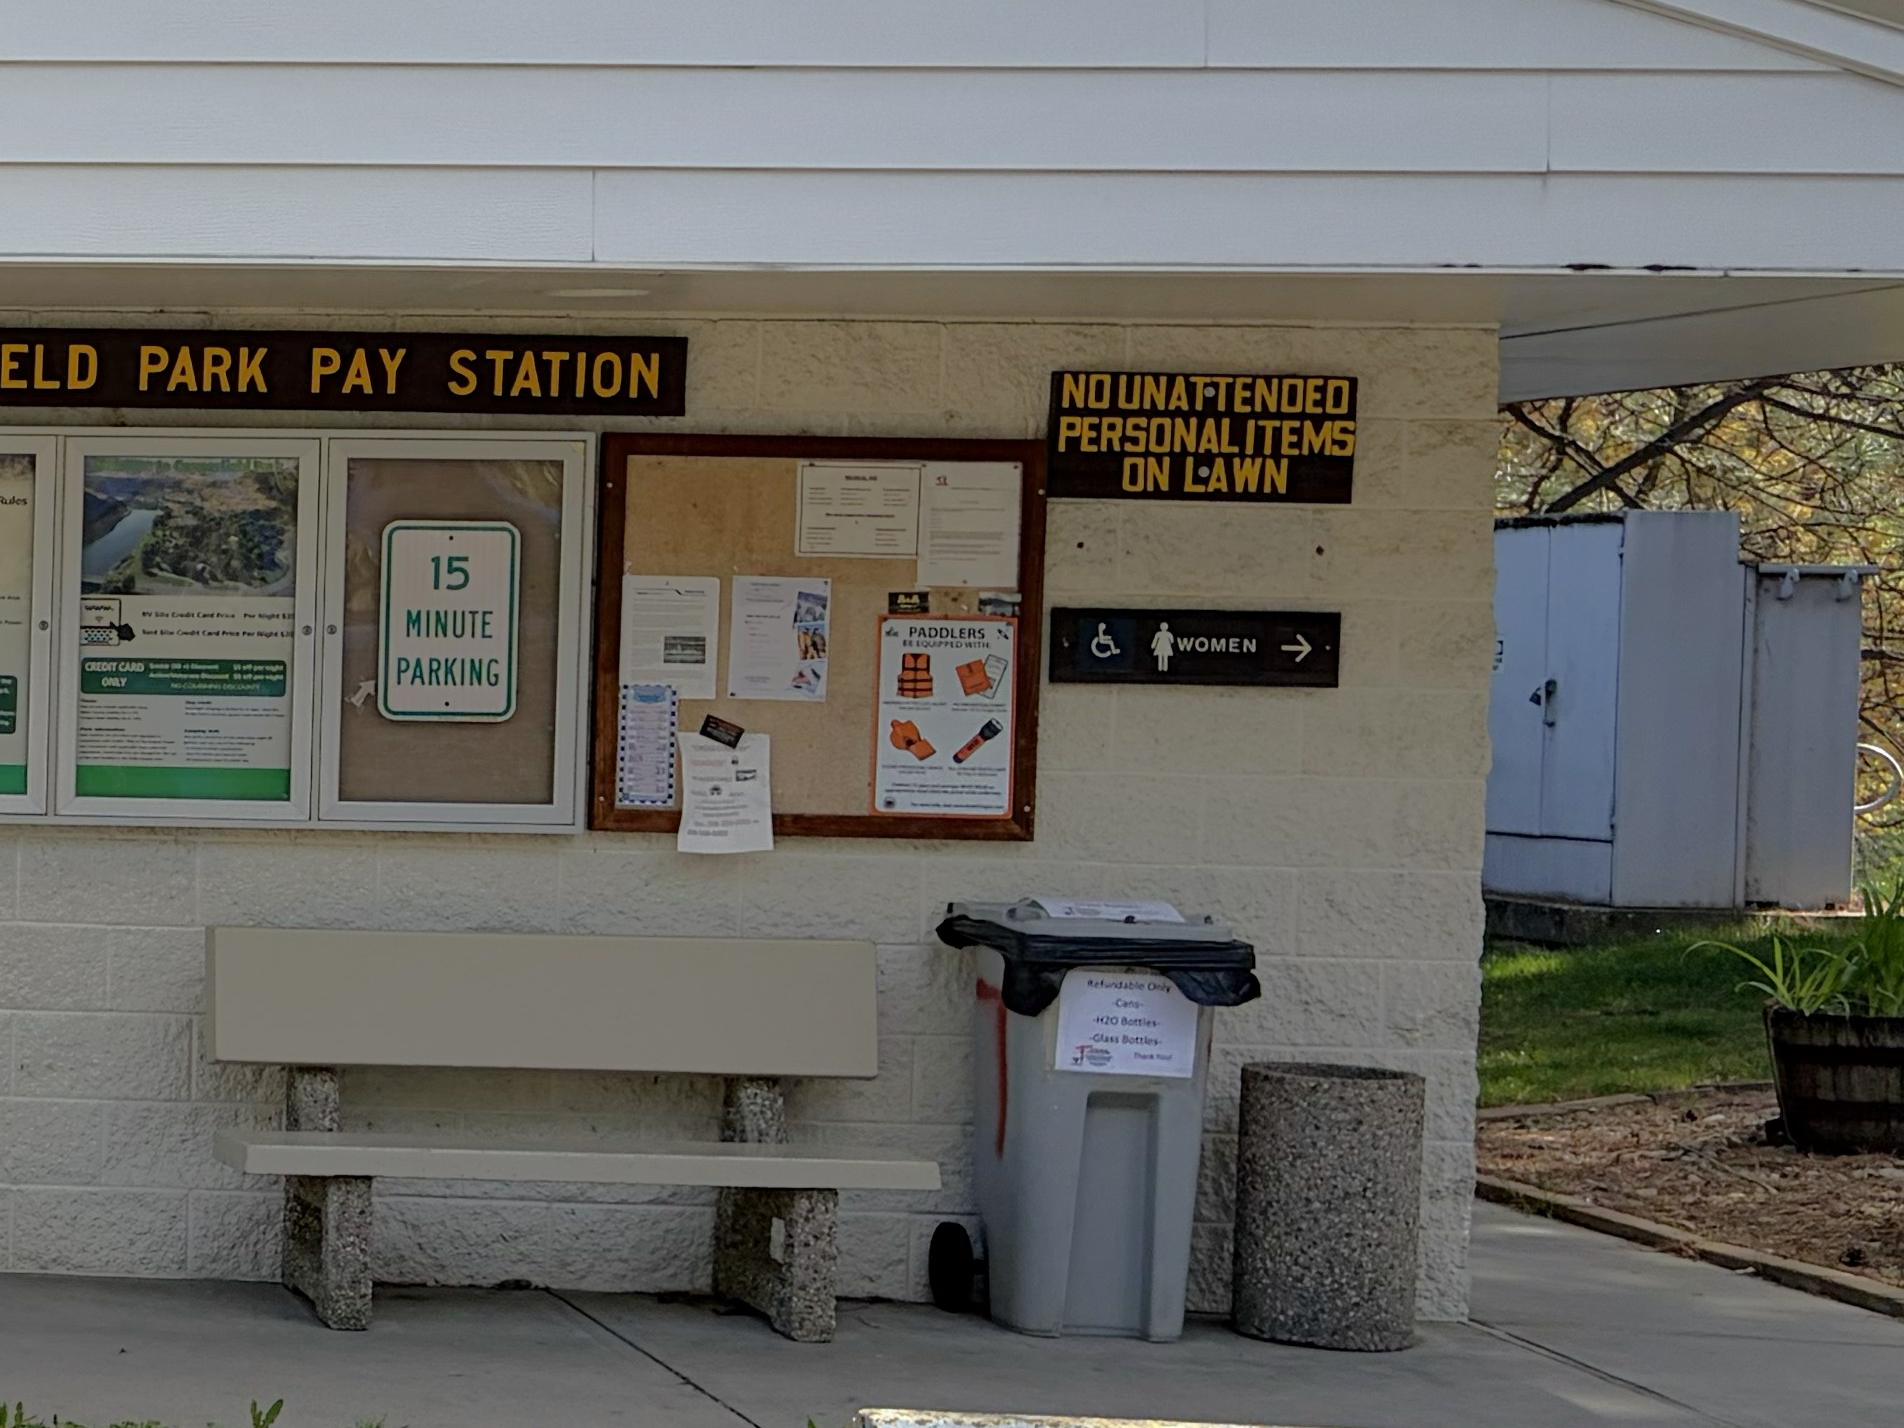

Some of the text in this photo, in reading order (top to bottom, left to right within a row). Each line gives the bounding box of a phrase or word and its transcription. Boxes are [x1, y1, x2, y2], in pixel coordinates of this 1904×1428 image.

[139, 345, 268, 394] PARK
[311, 347, 406, 395] PAY
[447, 349, 661, 400] STATION
[1061, 373, 1350, 415] NO UNATTENDED
[1057, 416, 1357, 457] PERSONAL ITEMS
[1122, 456, 1289, 494] ON LAWN
[430, 555, 471, 591] 15
[405, 610, 494, 639] MINUTE
[909, 626, 986, 640] PADDLERS
[916, 640, 963, 649] EQUIPPED
[1177, 637, 1257, 653] WOMEN
[85, 662, 117, 671] CREDIT
[118, 662, 145, 672] CARD
[396, 657, 500, 687] PARKING
[101, 677, 128, 687] ONLY
[1087, 978, 1172, 993] Refundable Only
